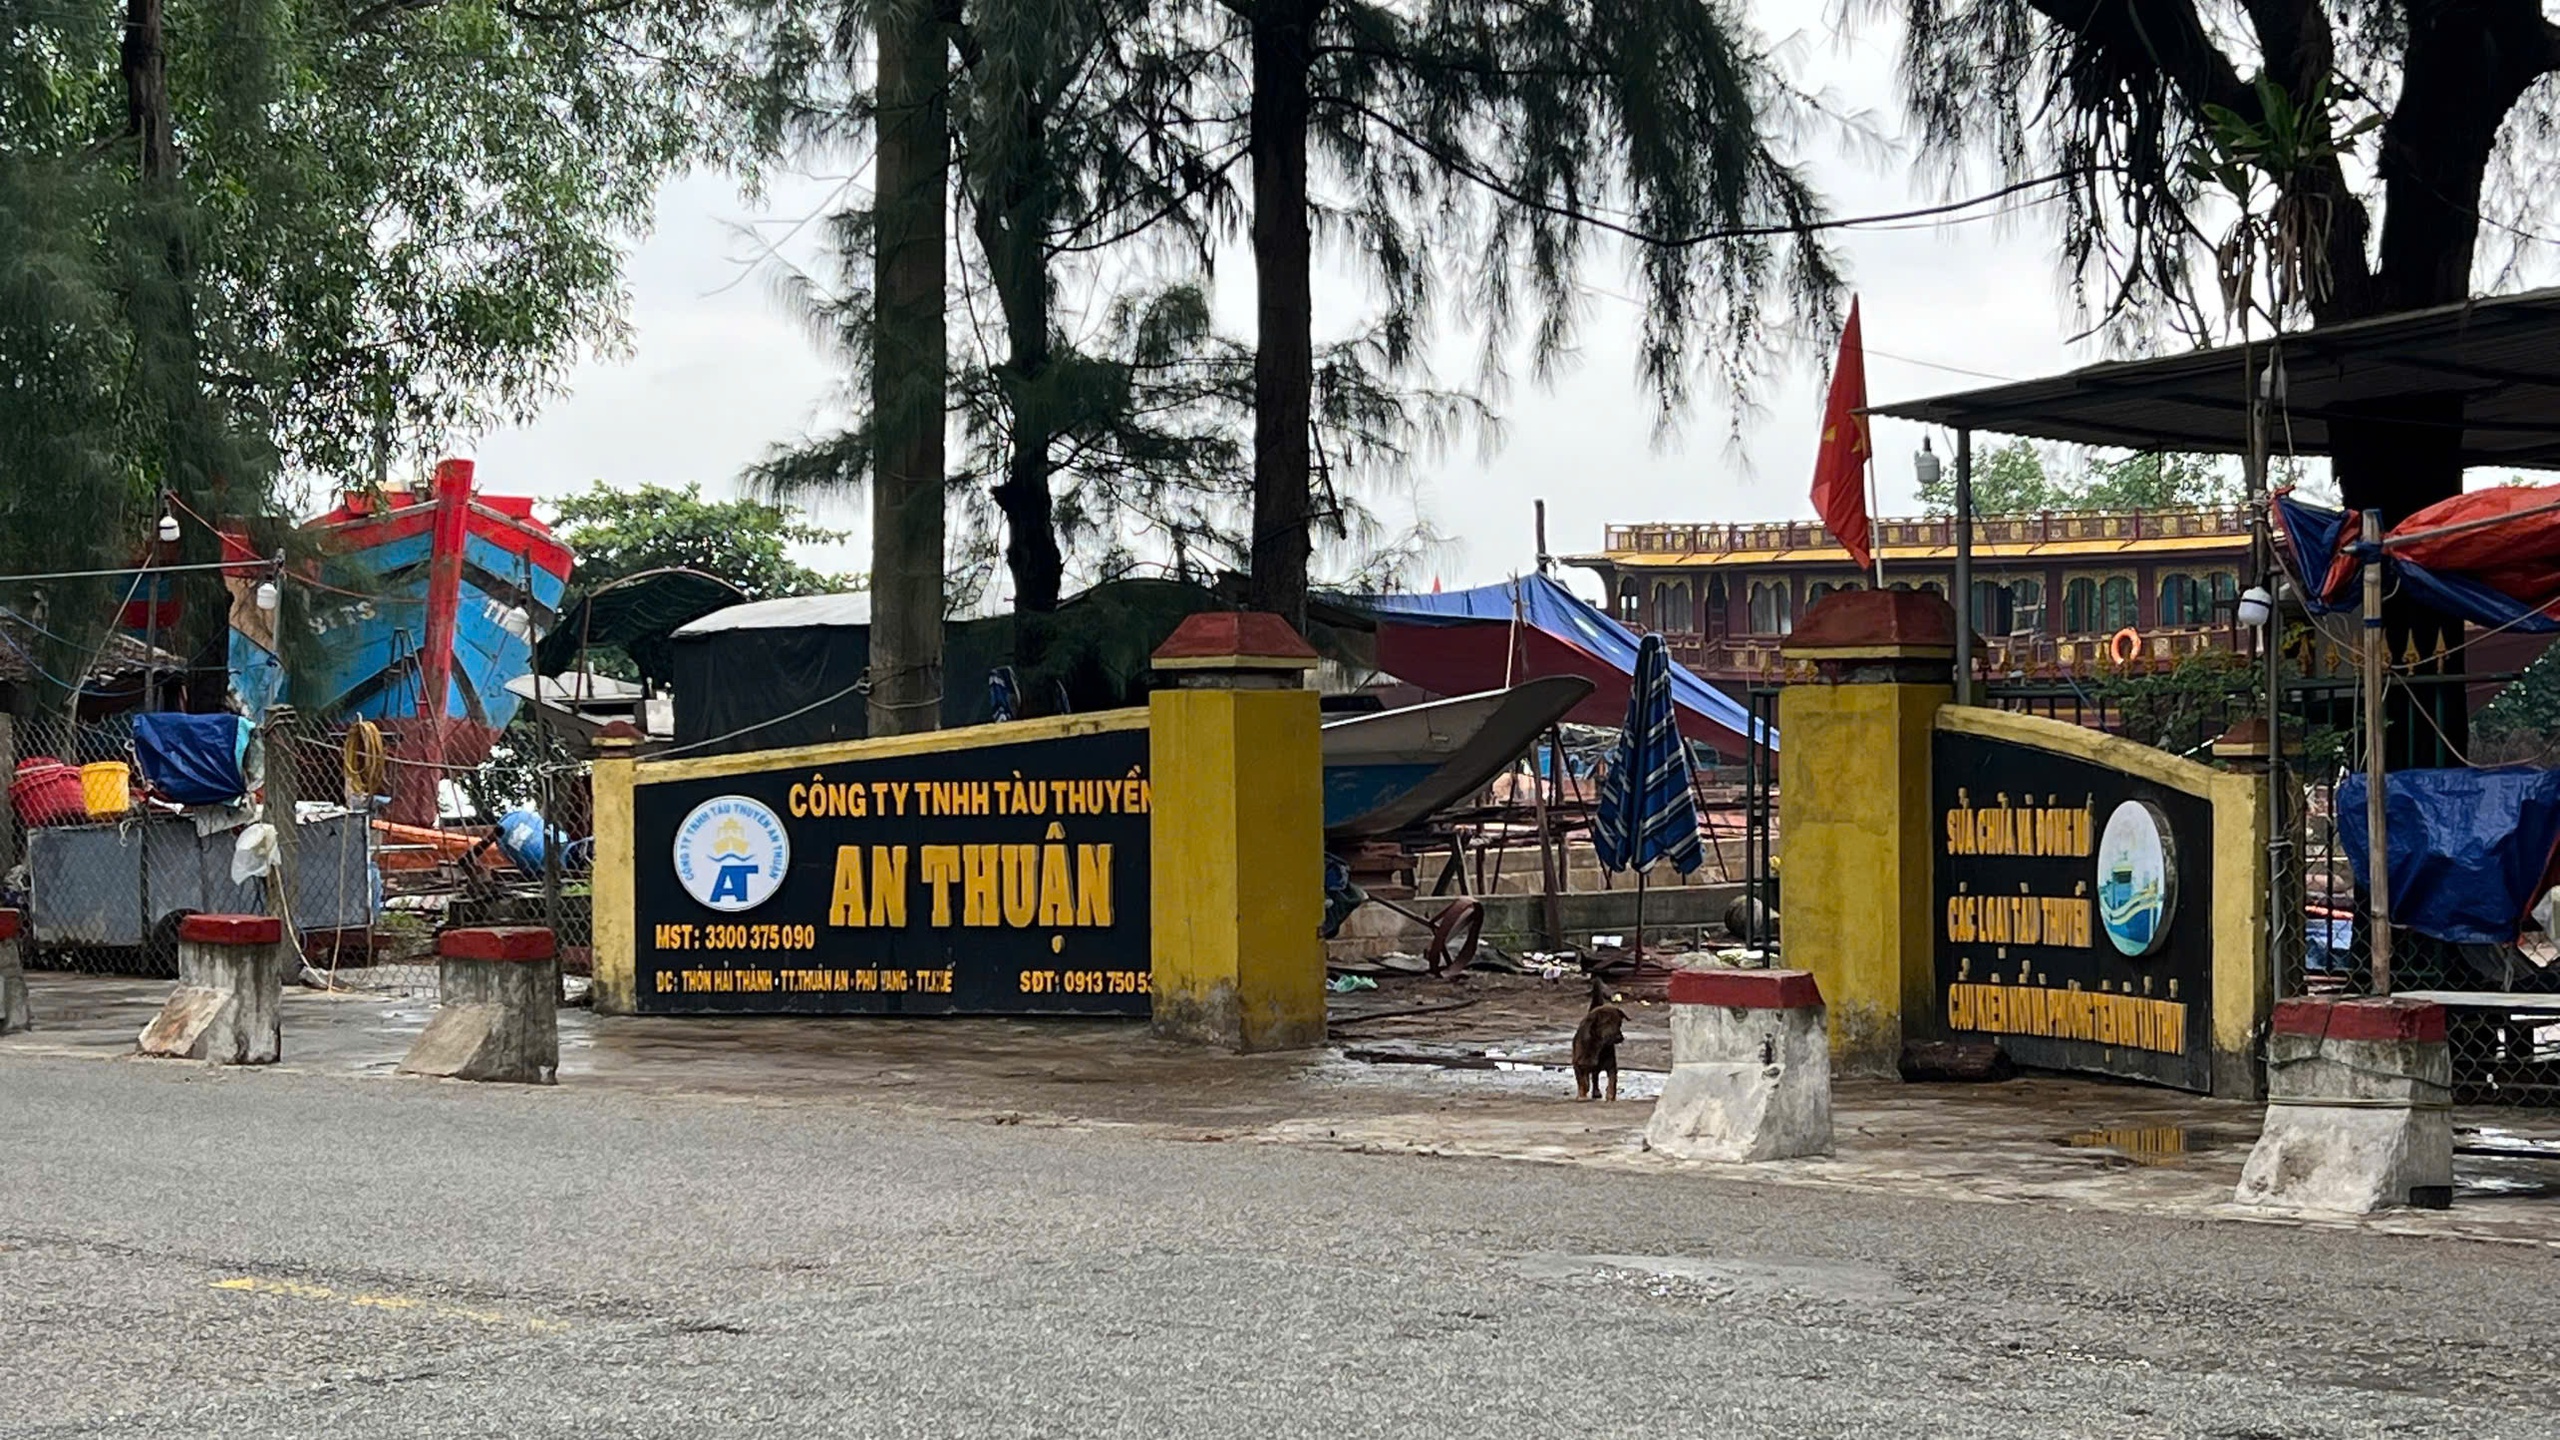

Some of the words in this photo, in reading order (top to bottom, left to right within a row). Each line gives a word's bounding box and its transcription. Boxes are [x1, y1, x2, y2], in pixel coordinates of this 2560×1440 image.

[789, 773, 866, 817] CÔNG
[872, 782, 909, 816] TY
[914, 782, 989, 816] TNHH
[994, 770, 1046, 815] TÀU
[1051, 765, 1154, 814] THUYỀN
[710, 865, 758, 902] AT
[829, 845, 908, 927] AN
[921, 821, 1114, 953] THUẬN
[655, 924, 700, 950] MST:
[705, 924, 747, 950] 3300
[750, 924, 780, 950] 375
[782, 924, 815, 950] 090
[1064, 970, 1103, 993] 0913
[1106, 970, 1135, 993] 750
